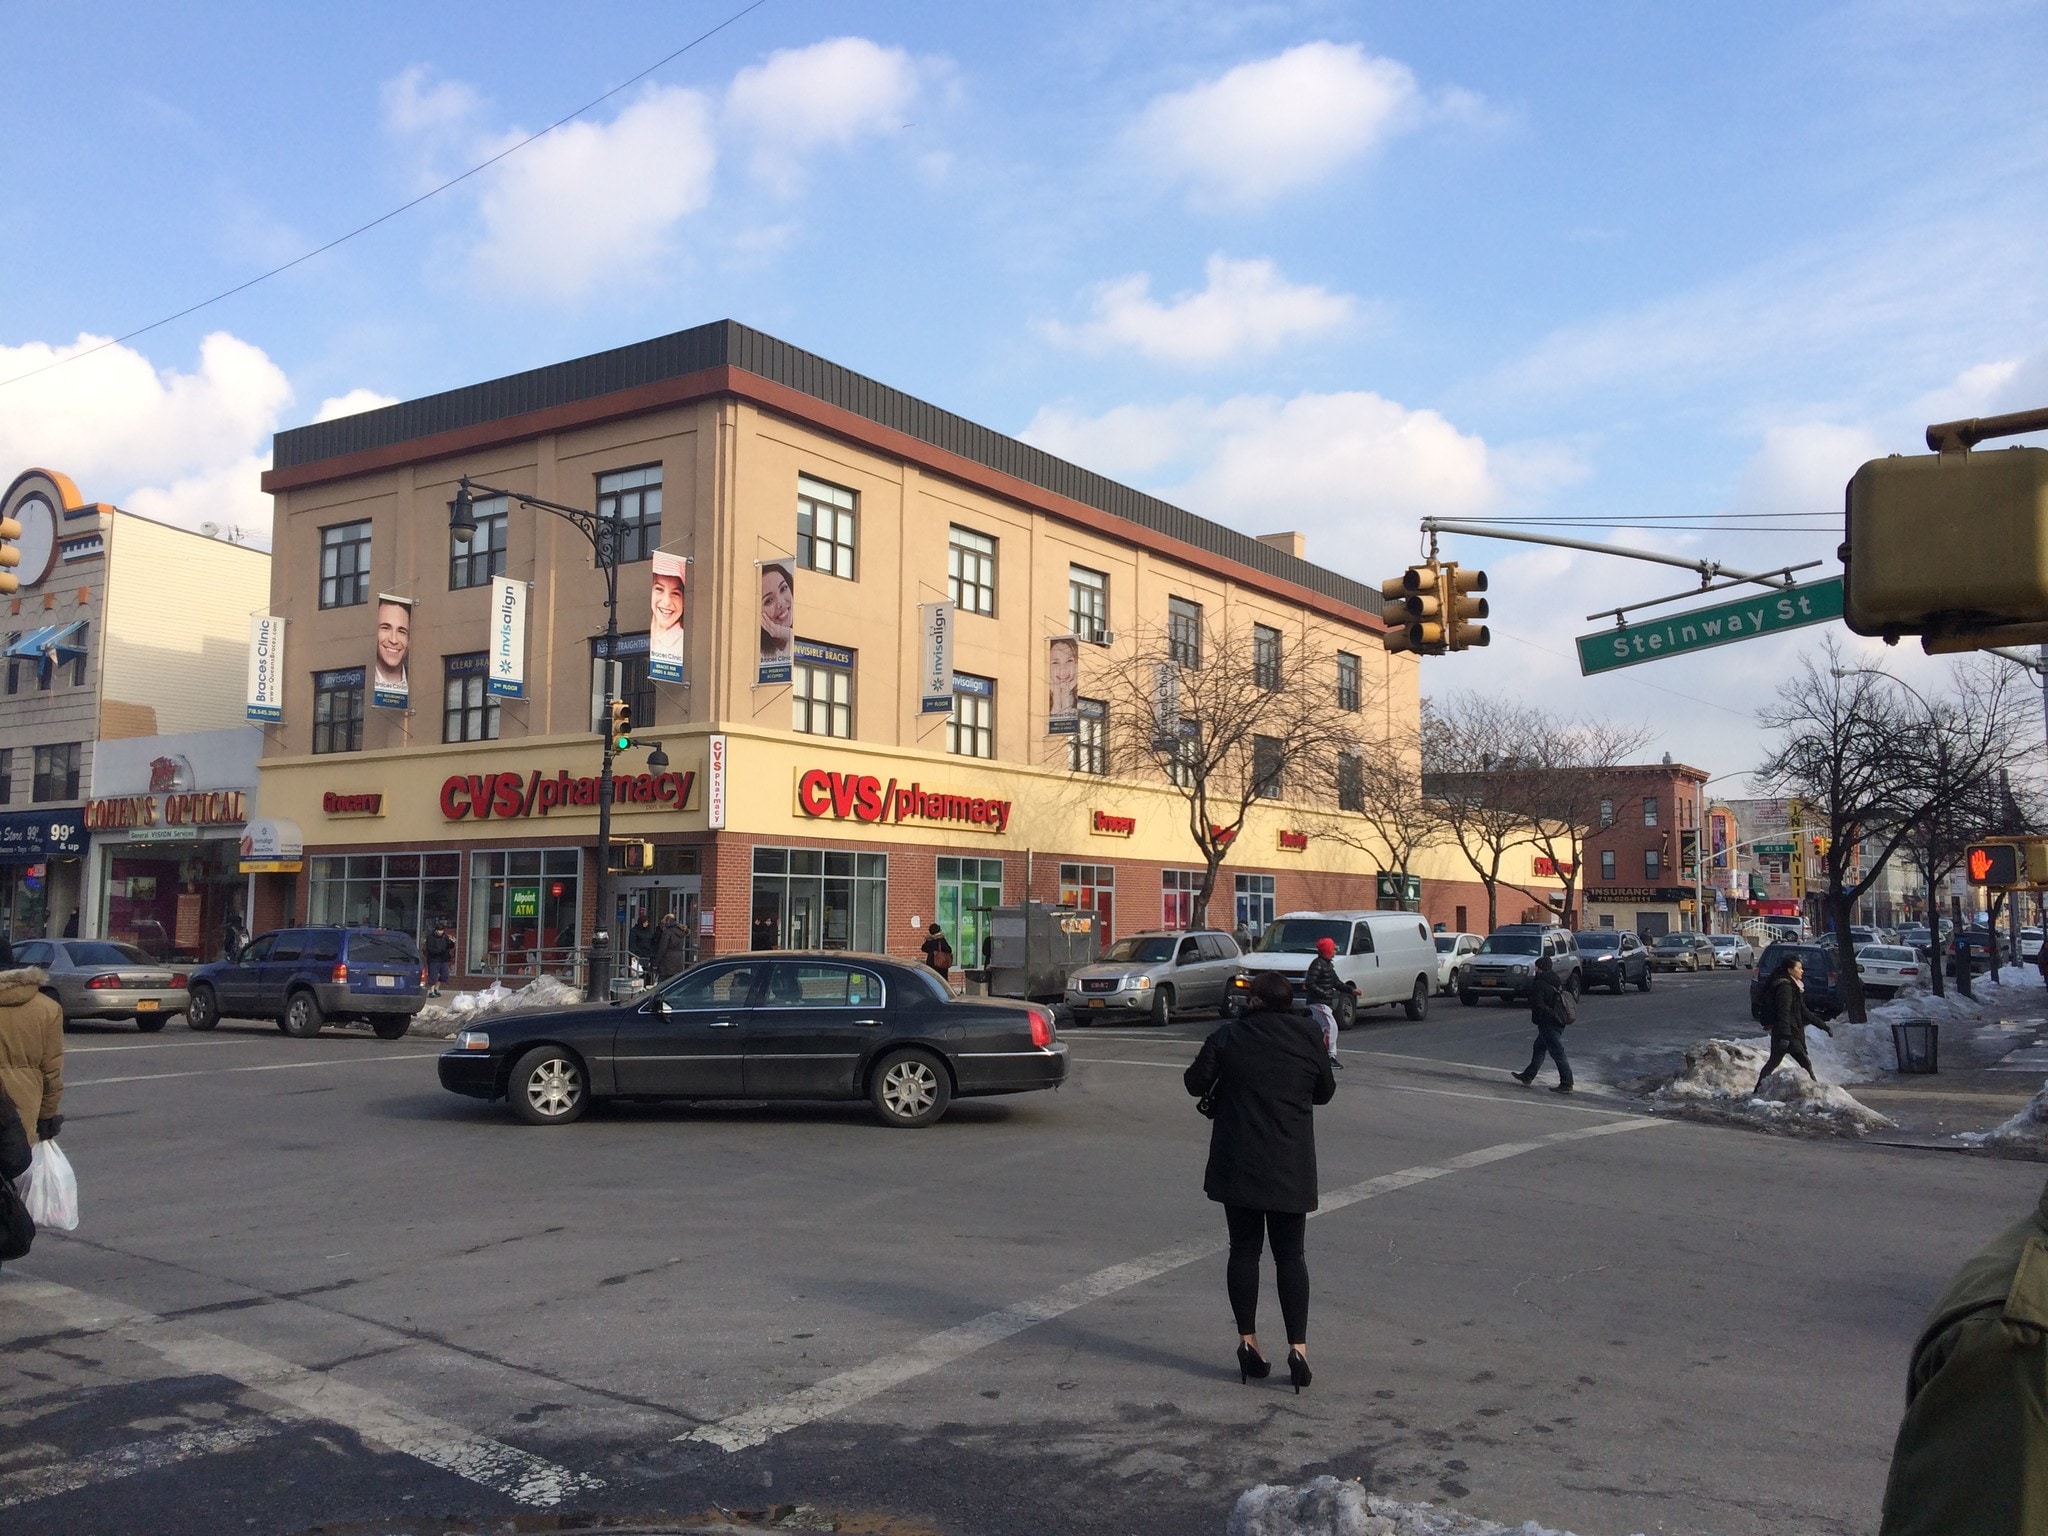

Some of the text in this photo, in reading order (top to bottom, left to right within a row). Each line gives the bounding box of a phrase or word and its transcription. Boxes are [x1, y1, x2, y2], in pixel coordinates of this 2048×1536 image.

[500, 585, 515, 657] invisalign
[1613, 595, 1812, 658] Steinway St
[616, 639, 648, 651] TRAIGHTEN
[933, 608, 946, 675] invisalign
[256, 620, 270, 702] Braces Clinic
[794, 644, 849, 663] NVISIBLE BRACES
[451, 657, 489, 670] CLEAR BRA
[324, 672, 361, 685] invisalign
[502, 683, 518, 691] FLOOR
[953, 677, 983, 692] nvisalign
[713, 741, 722, 771] CVS
[323, 791, 382, 815] Grocery
[440, 769, 696, 820] CVS/pharmacy
[799, 769, 1012, 831] CVS/pharmacy
[84, 790, 247, 830] COHEN'S OPTICAL
[50, 823, 75, 841] 99¢
[1094, 810, 1136, 838] Grocery
[131, 831, 149, 840] General
[173, 830, 194, 838] Services
[59, 842, 80, 852] & up
[513, 892, 536, 904] Allpoint
[1591, 888, 1657, 896] INSURANCE
[515, 904, 534, 915] ATM
